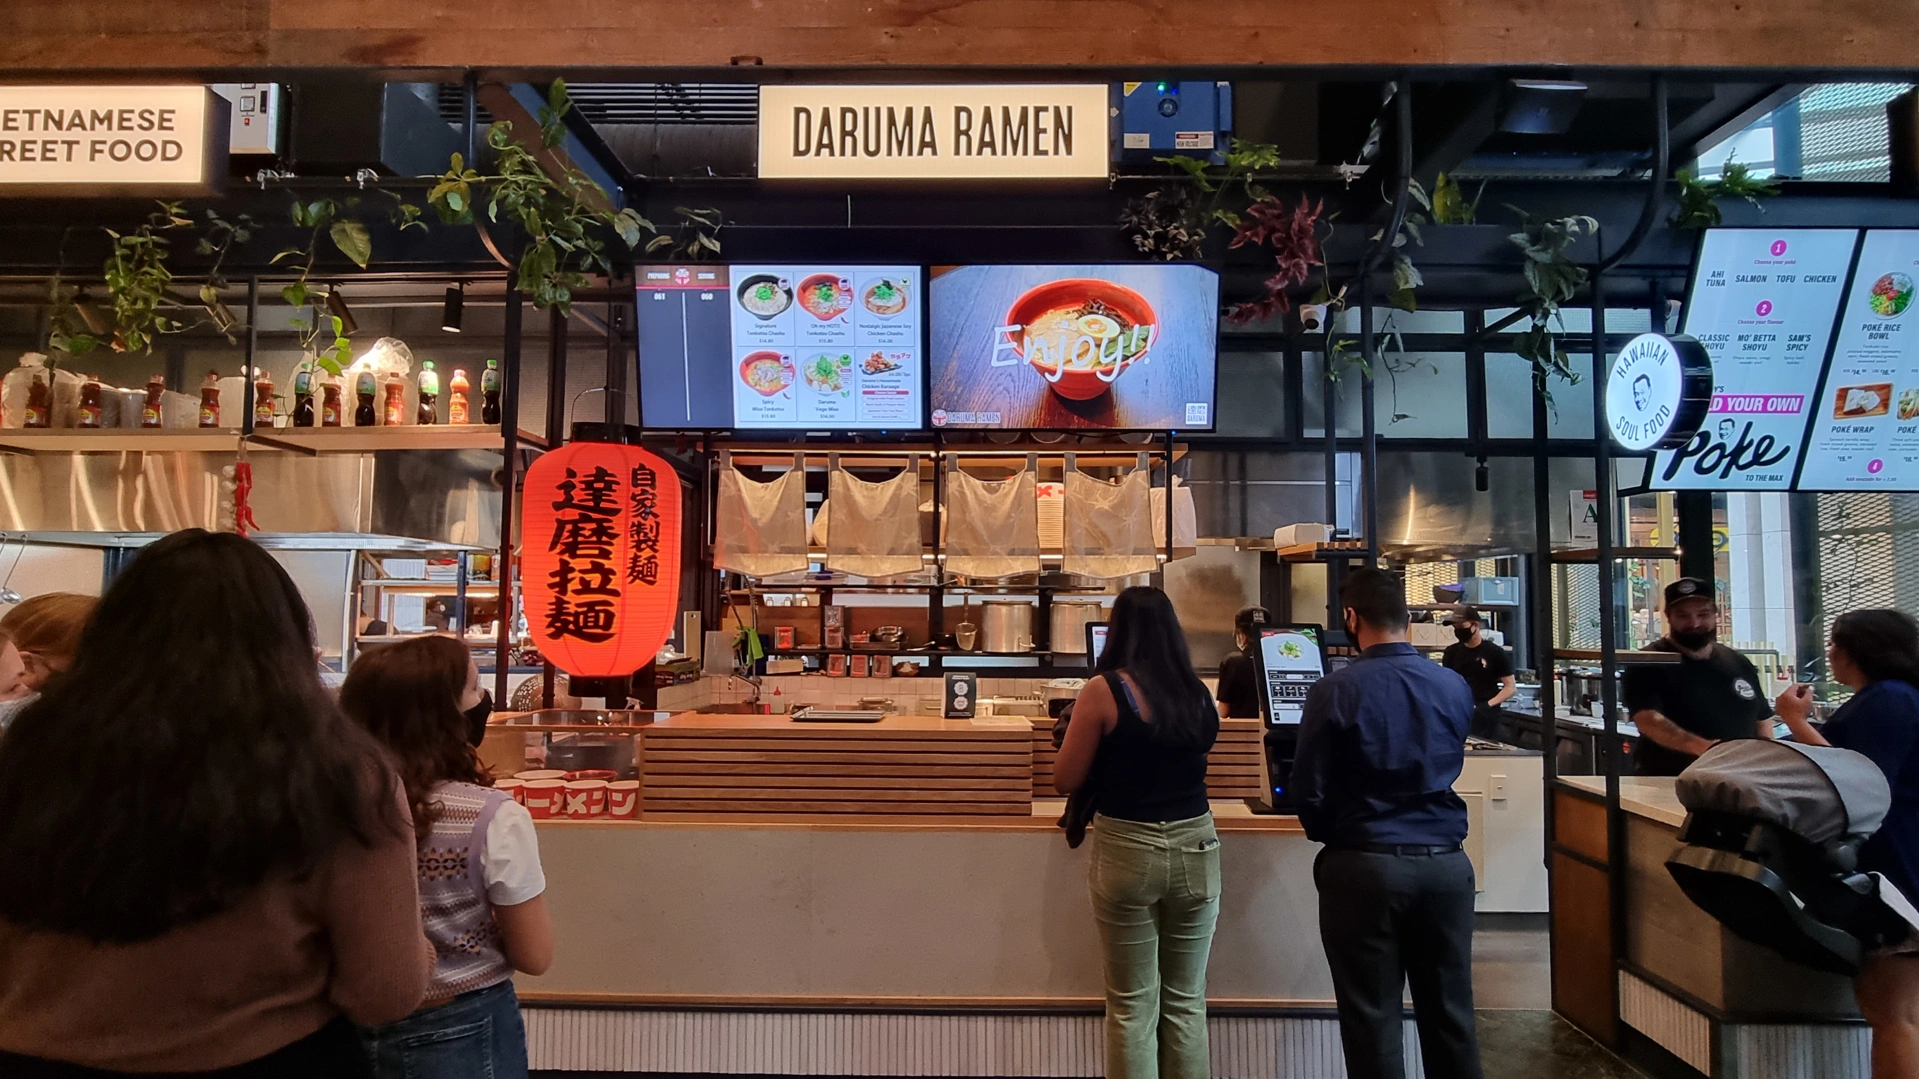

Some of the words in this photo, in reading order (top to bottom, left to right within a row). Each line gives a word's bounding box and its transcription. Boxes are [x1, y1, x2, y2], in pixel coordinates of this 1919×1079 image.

[2, 108, 176, 132] ETNAMESE
[793, 106, 938, 157] DARUMA
[954, 105, 1073, 157] RAMEN
[89, 139, 183, 162] FOOD
[1775, 243, 1782, 253] 1
[1705, 279, 1727, 287] TUNA
[1735, 275, 1768, 283] SALMON
[1776, 275, 1797, 283] TOFU
[1804, 275, 1838, 283] CHICKEN
[1760, 304, 1767, 313] 2
[1861, 323, 1883, 332] POKÉ
[1883, 323, 1902, 332] RICE
[1698, 334, 1730, 342] CLASSIC
[1753, 334, 1777, 342] BETTA
[1787, 334, 1812, 342] SAM'S
[1867, 332, 1890, 340] BOWL
[1741, 343, 1768, 351] SHOYU
[1785, 343, 1809, 351] SPICY
[990, 322, 1155, 383] Enjoy!!
[1616, 341, 1669, 379] HAWAIIAN
[1727, 397, 1764, 412] YOUR
[1766, 397, 1801, 412] OWN
[1616, 415, 1640, 441] SOUL
[1643, 404, 1671, 440] FOOD
[1831, 425, 1852, 433] POKÉ
[1852, 426, 1875, 434] WRAP
[1896, 425, 1918, 434] POKÉ
[1745, 474, 1754, 482] TO
[1755, 474, 1768, 482] THE
[1768, 474, 1783, 482] MAX
